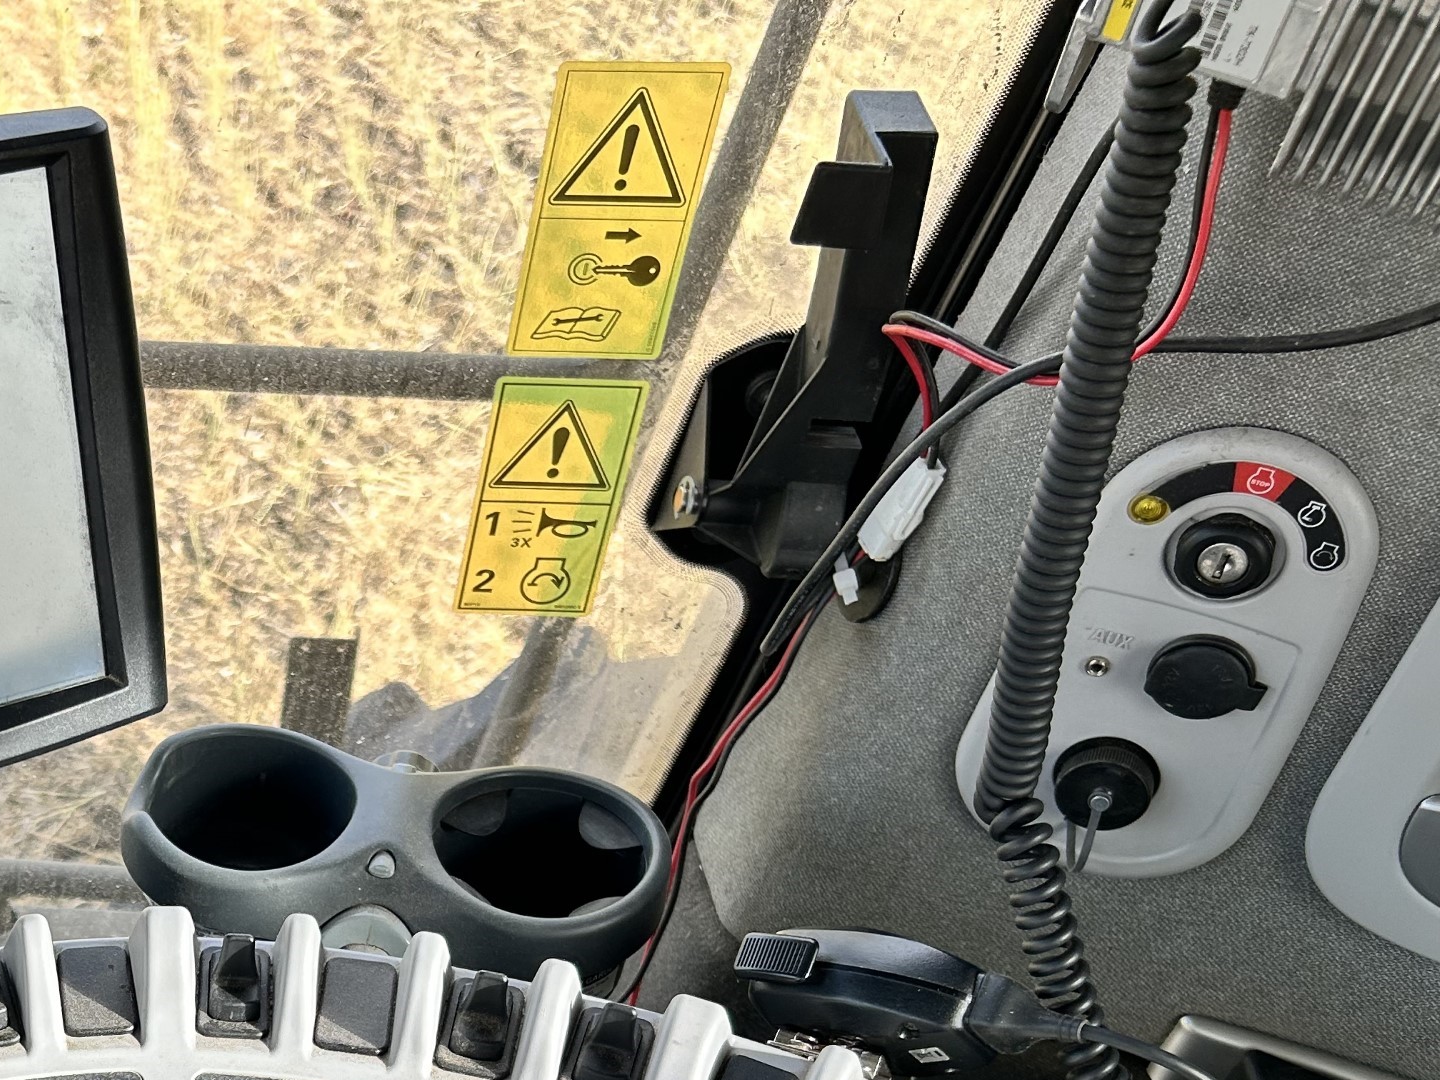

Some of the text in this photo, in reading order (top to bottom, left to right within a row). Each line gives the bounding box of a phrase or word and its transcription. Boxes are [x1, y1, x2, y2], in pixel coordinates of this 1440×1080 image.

[1250, 478, 1271, 489] STOP
[484, 511, 500, 536] 1
[510, 537, 532, 548] 3X
[472, 569, 495, 593] 2
[1088, 626, 1135, 650] AUX
